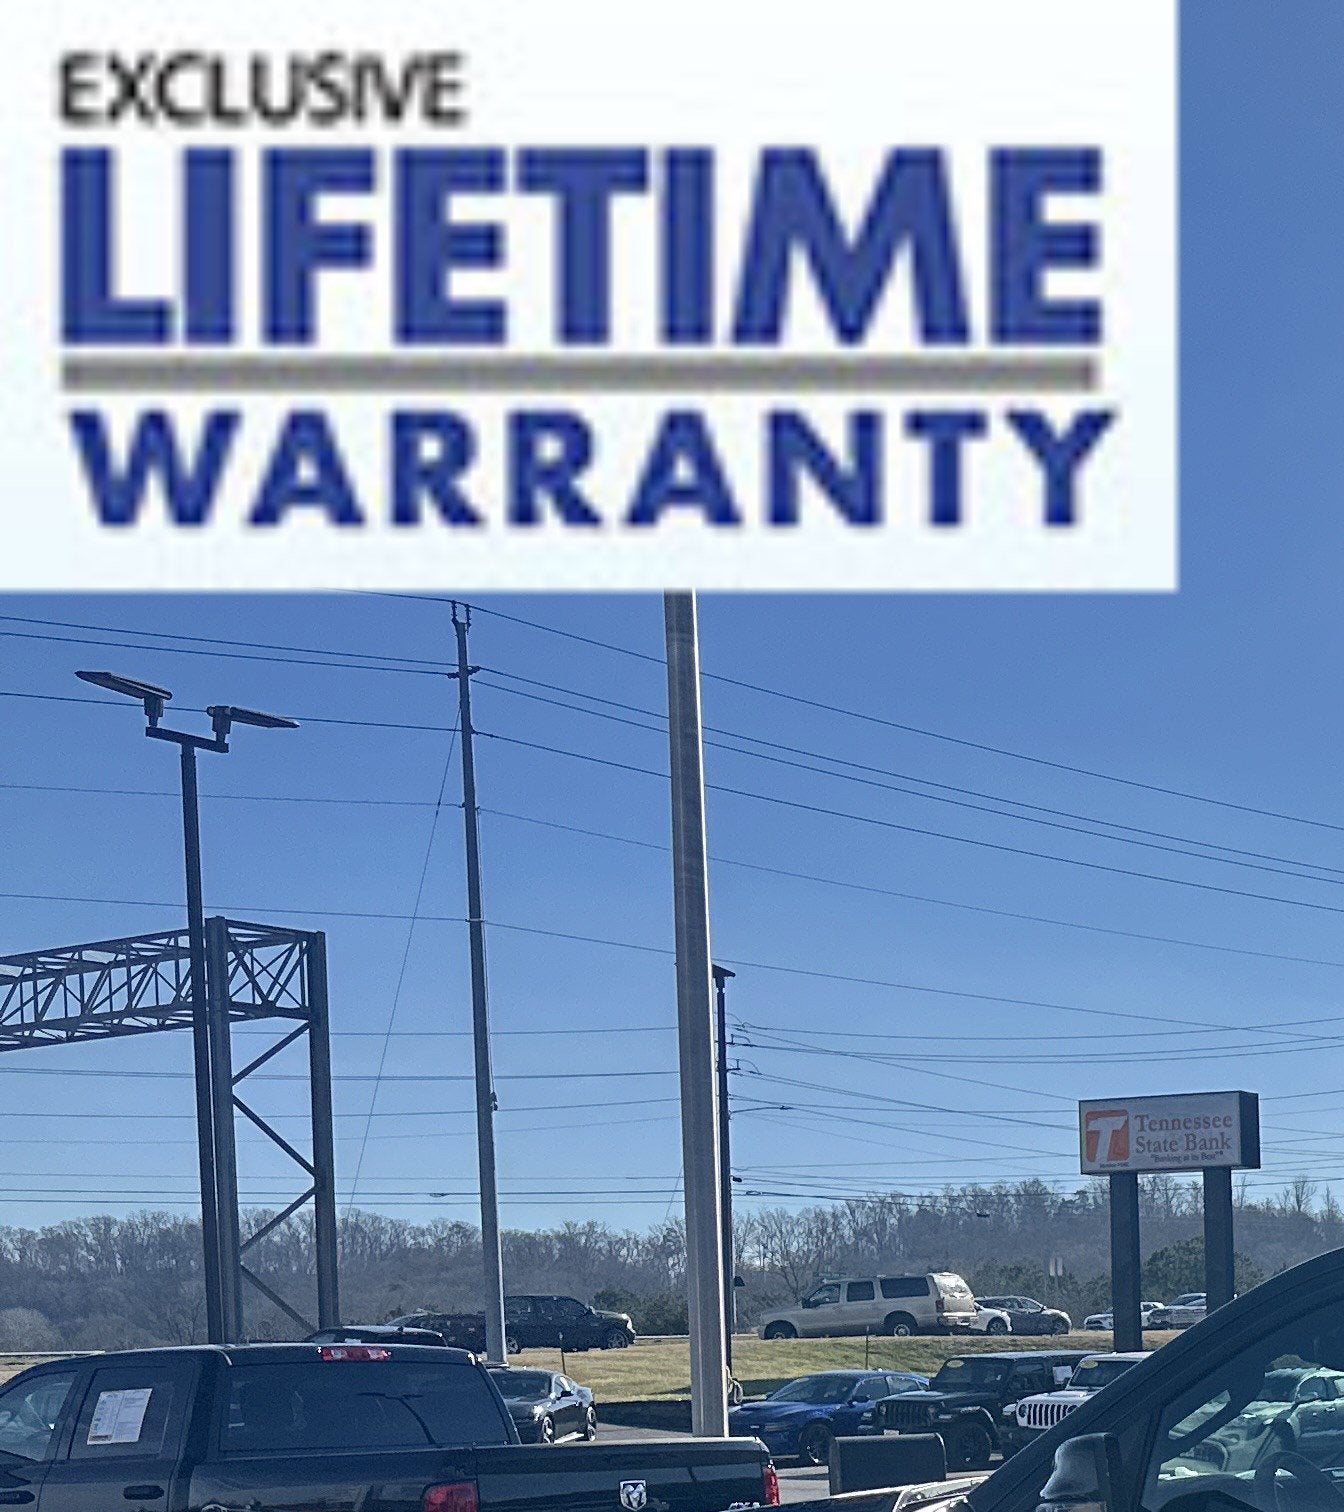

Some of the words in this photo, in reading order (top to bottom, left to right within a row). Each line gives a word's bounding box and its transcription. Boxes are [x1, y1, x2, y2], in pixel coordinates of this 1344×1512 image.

[1134, 1113, 1233, 1133] Tennessee
[1135, 1134, 1179, 1154] State
[1184, 1131, 1232, 1152] Bank
